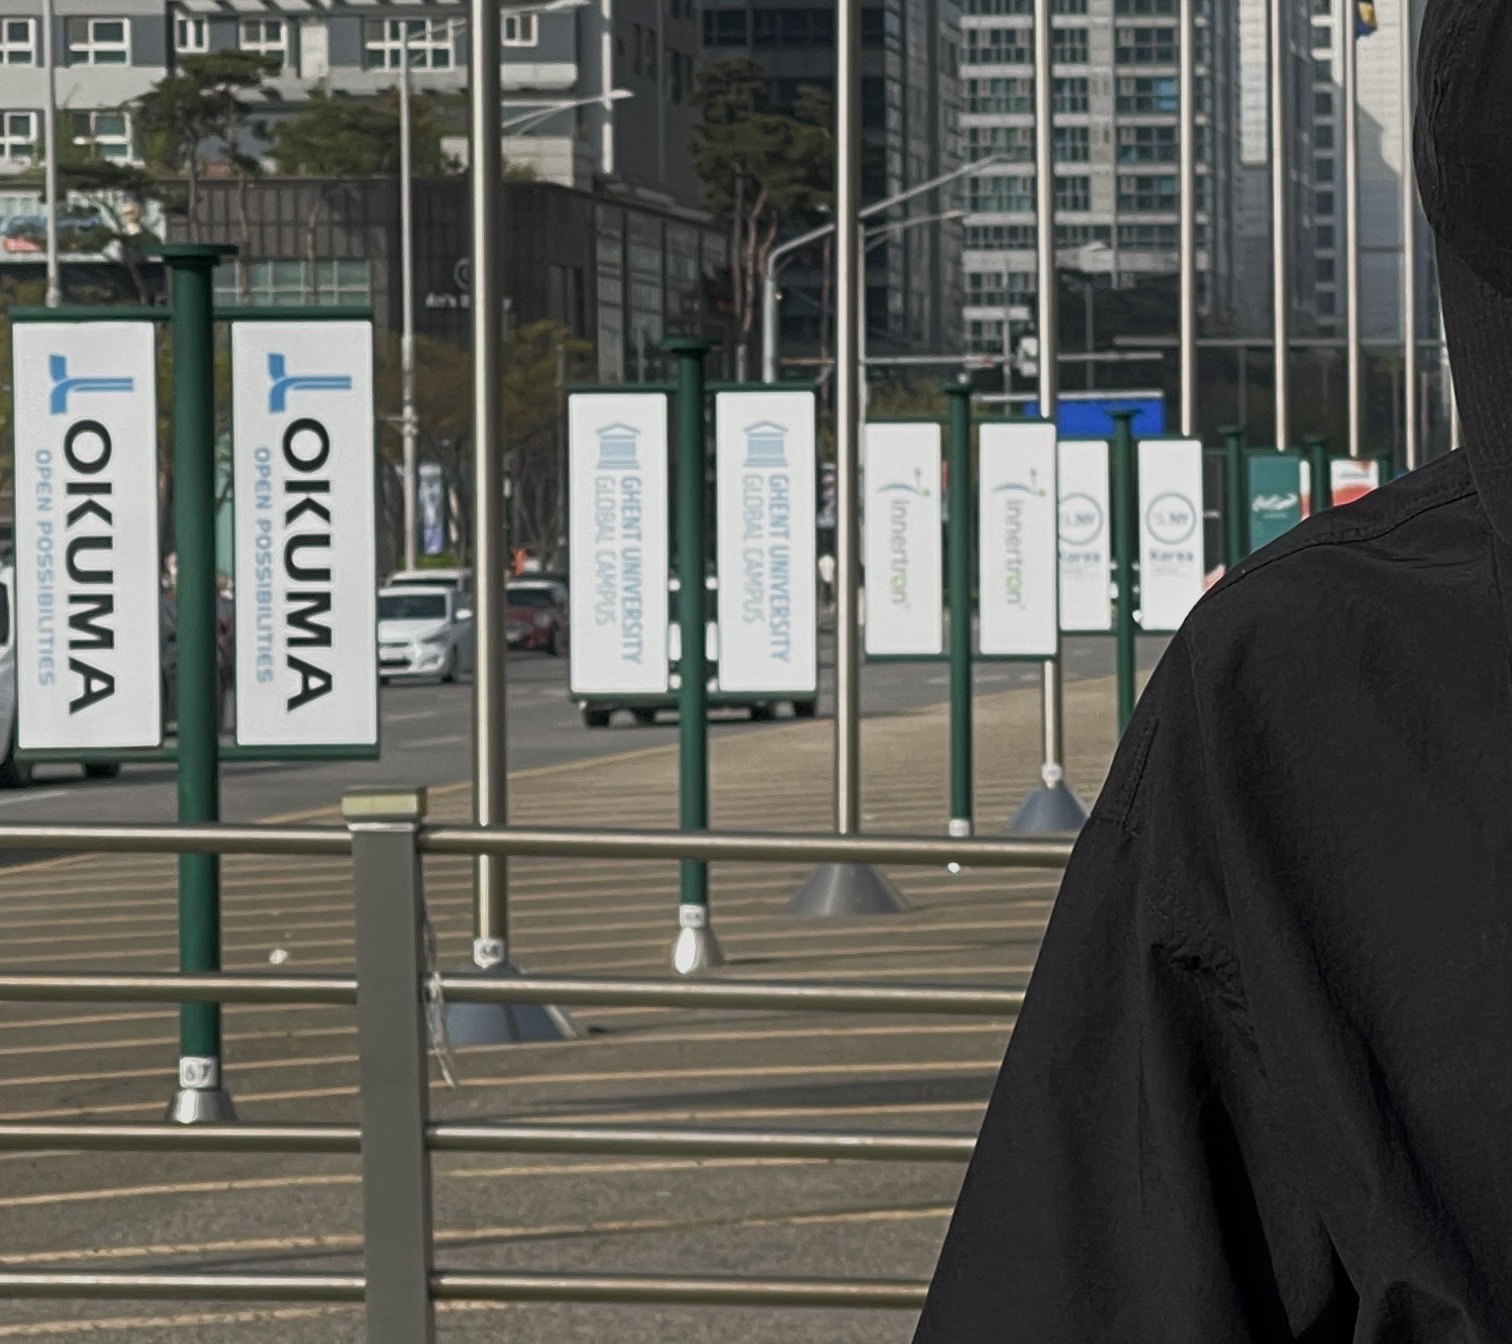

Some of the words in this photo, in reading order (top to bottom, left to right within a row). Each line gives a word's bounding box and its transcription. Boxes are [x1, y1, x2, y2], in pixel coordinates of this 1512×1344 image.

[34, 447, 54, 512] OPEN
[252, 445, 273, 510] OPEN
[594, 475, 617, 544] GLOBAL
[620, 475, 643, 542] GHENT
[767, 473, 791, 540] GHENT
[36, 519, 57, 687] POSSIBILITIES
[63, 419, 115, 715] OKUMA
[254, 517, 275, 684] POSSIBILITIES
[282, 417, 333, 712] OKUMA
[594, 549, 617, 626] CAMPUS
[620, 546, 644, 664] UNIVERSITY
[742, 547, 766, 624] CAMPUS
[768, 544, 792, 663] UNIVERSITY
[889, 498, 910, 605] innertron
[1004, 498, 1026, 605] innertron
